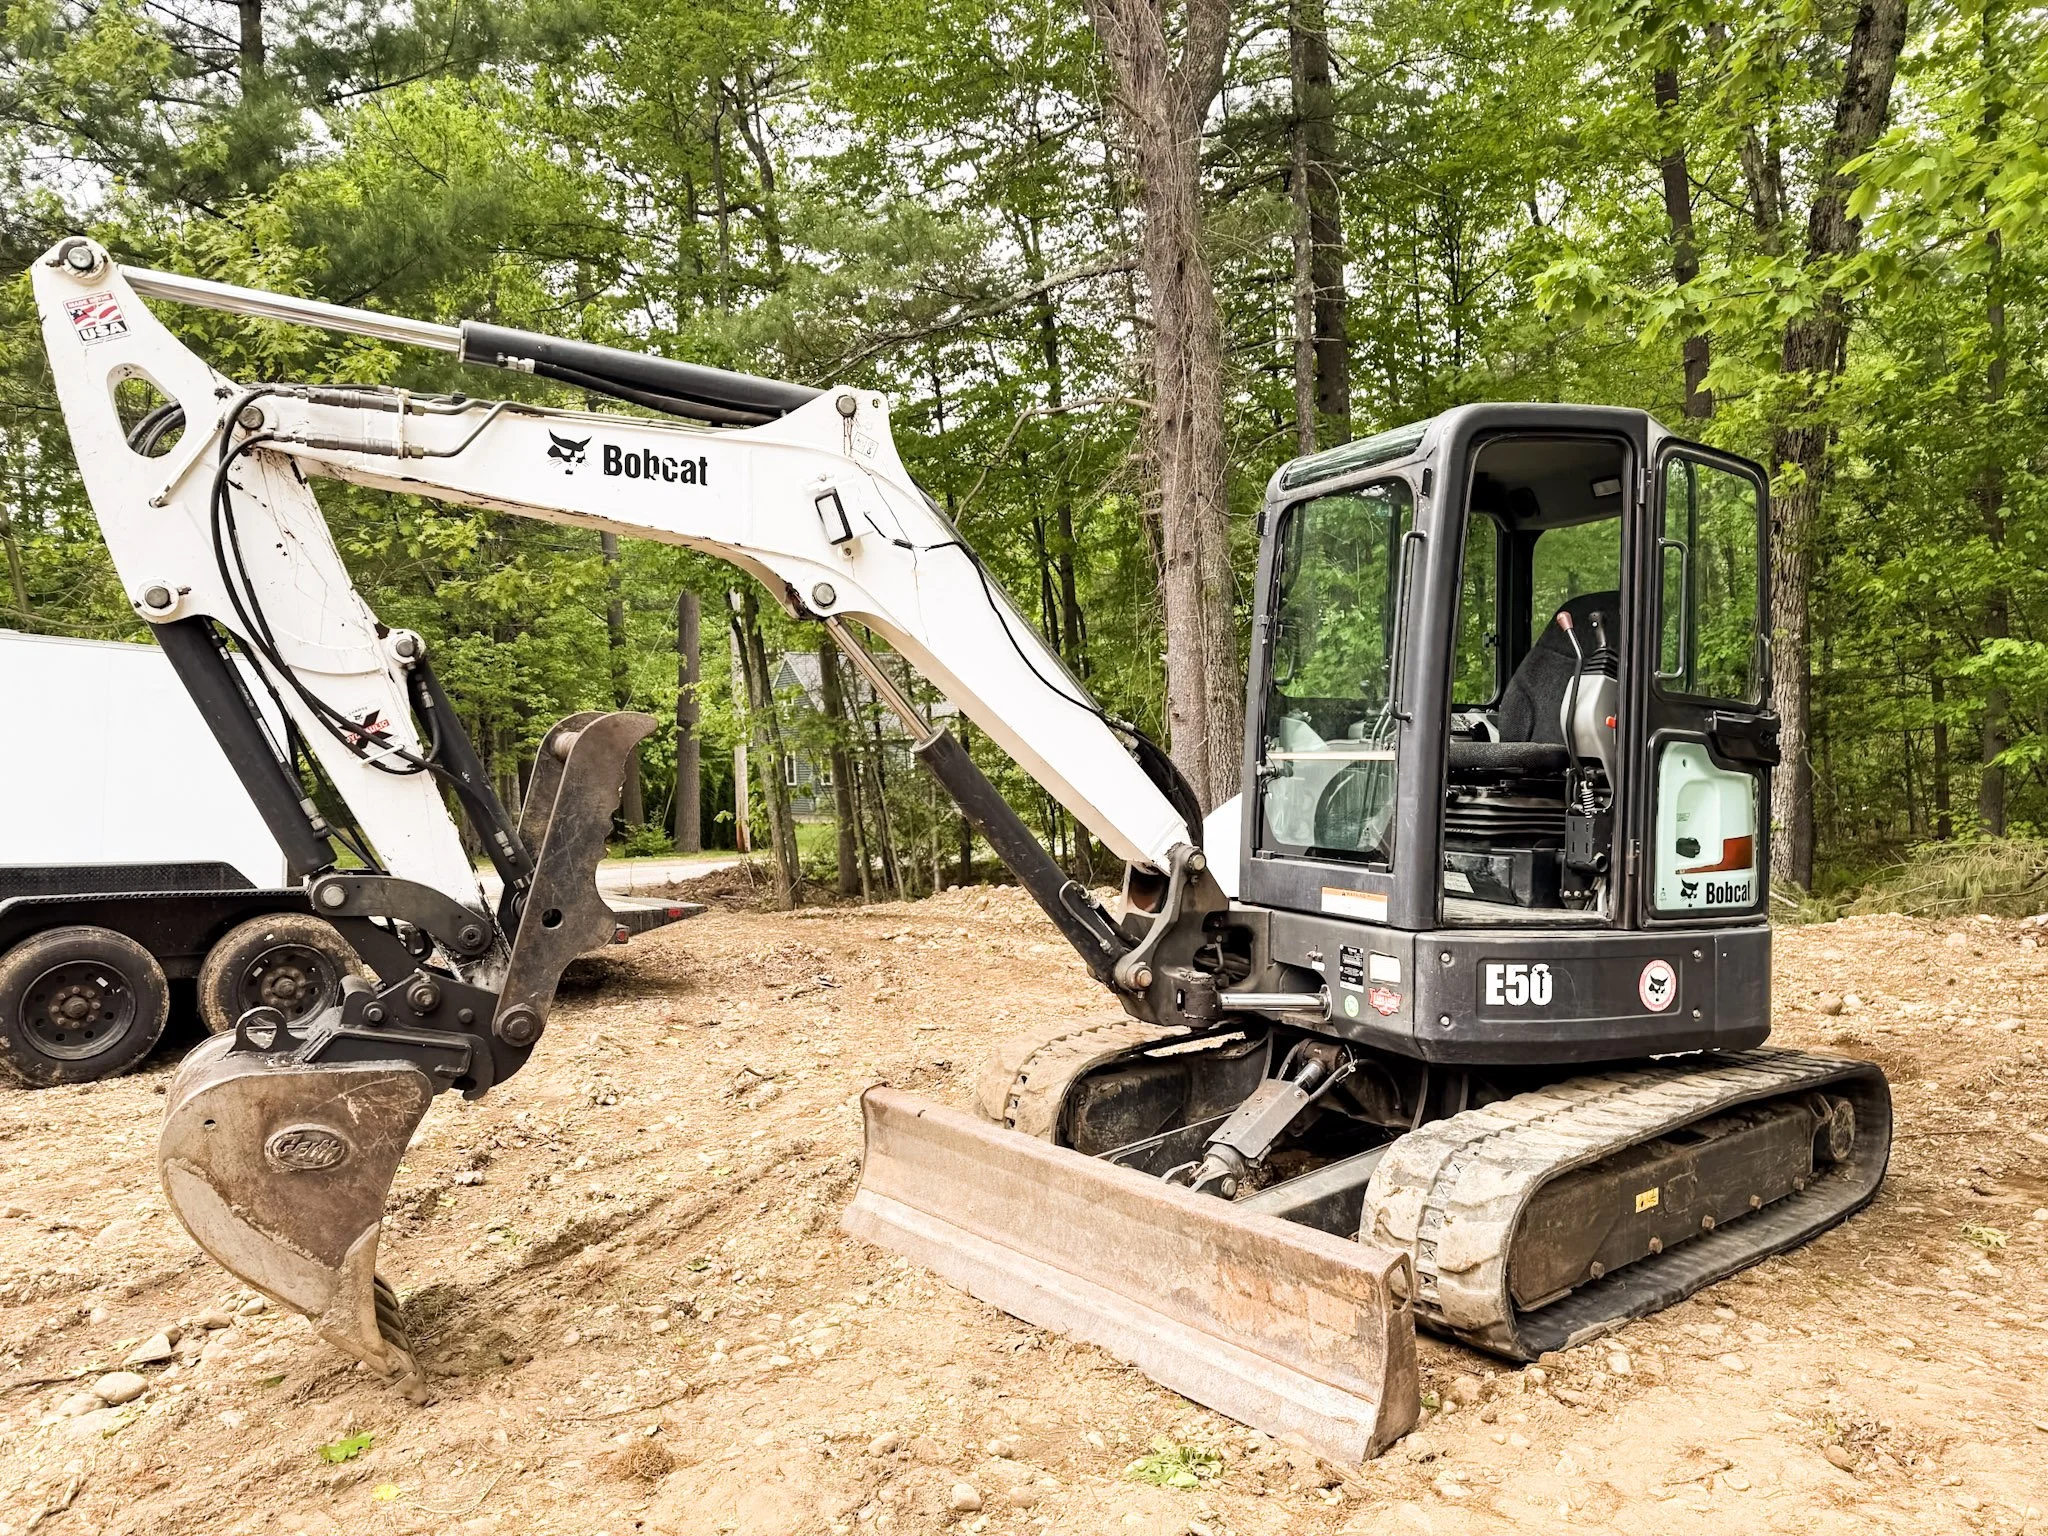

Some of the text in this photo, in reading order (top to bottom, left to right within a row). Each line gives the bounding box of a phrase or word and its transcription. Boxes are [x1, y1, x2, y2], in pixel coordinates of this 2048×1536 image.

[80, 322, 126, 341] USA
[603, 444, 708, 486] Bobcat
[345, 719, 389, 743] YAULIC
[1706, 880, 1751, 905] Bobcat
[1485, 963, 1553, 1006] E50
